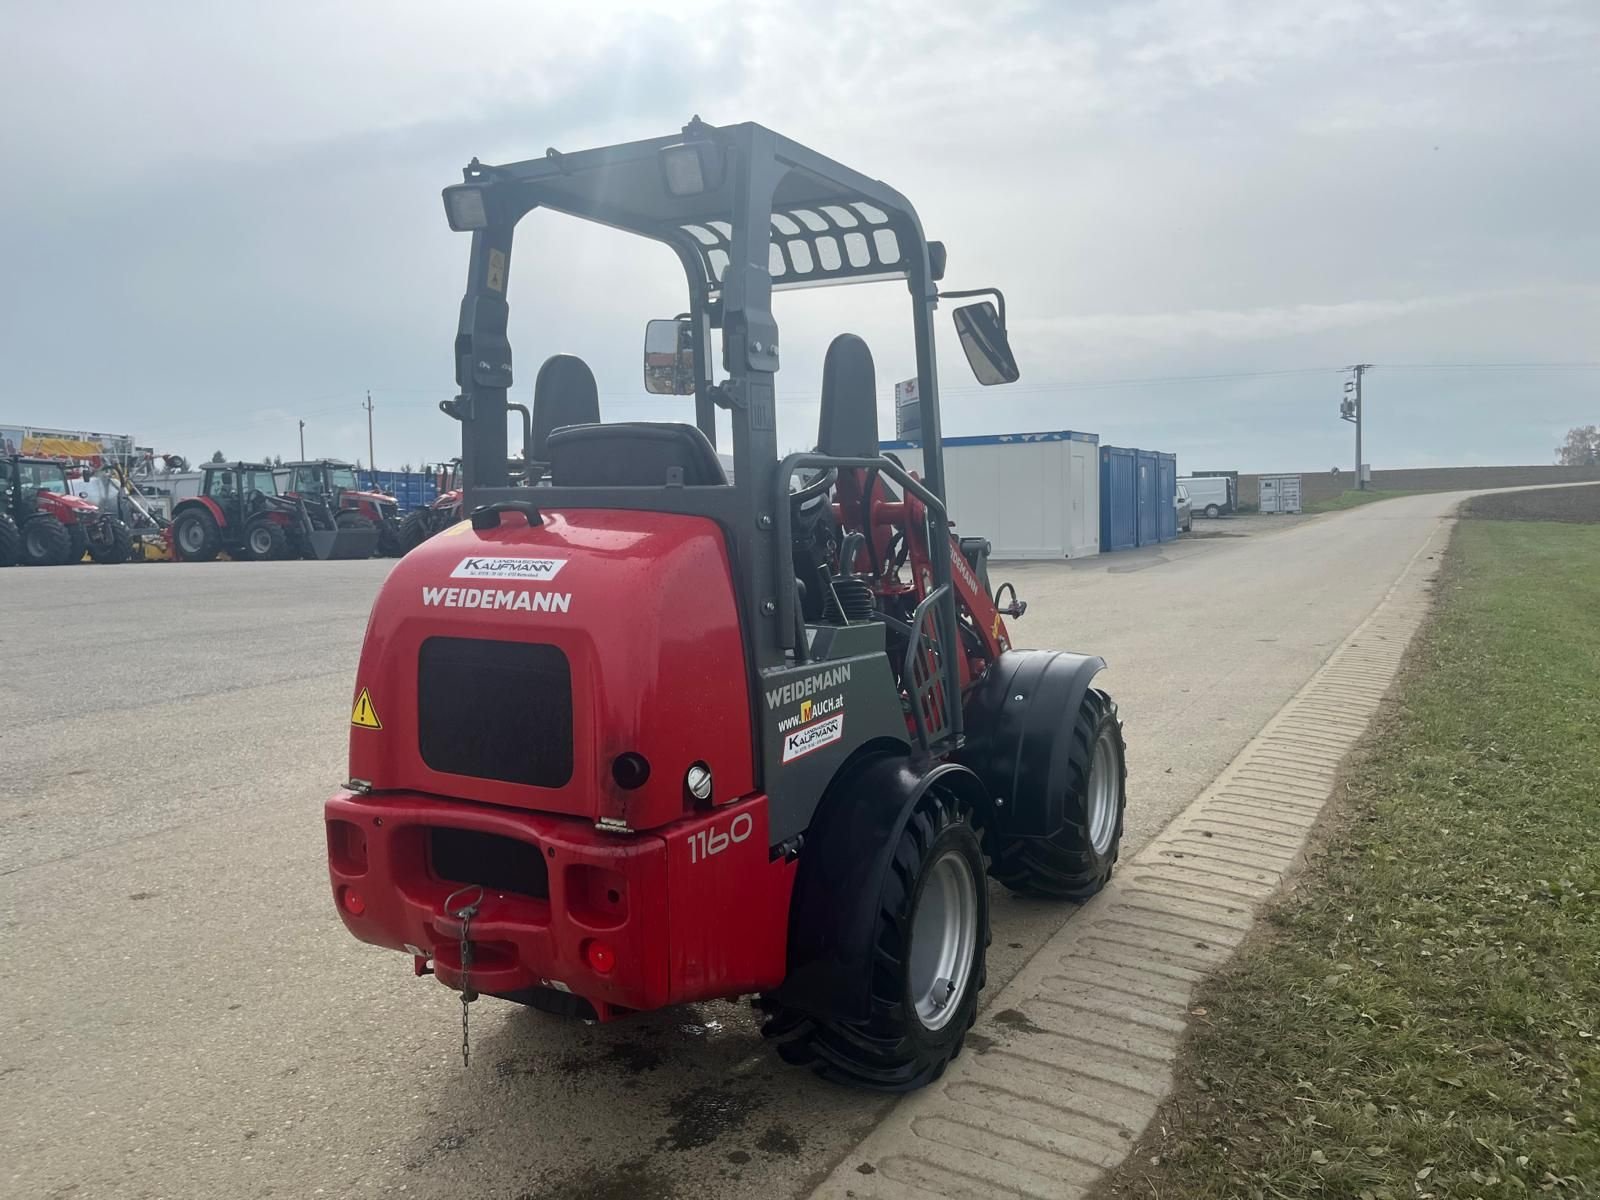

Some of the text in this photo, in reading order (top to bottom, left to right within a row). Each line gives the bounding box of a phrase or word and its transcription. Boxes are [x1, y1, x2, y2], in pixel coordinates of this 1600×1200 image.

[464, 559, 553, 572] KAUFMANN
[422, 586, 572, 613] WEIDEMANN
[765, 663, 851, 710] WEIDEMANN
[789, 723, 839, 750] KAUFMANN
[687, 812, 753, 864] 1160
